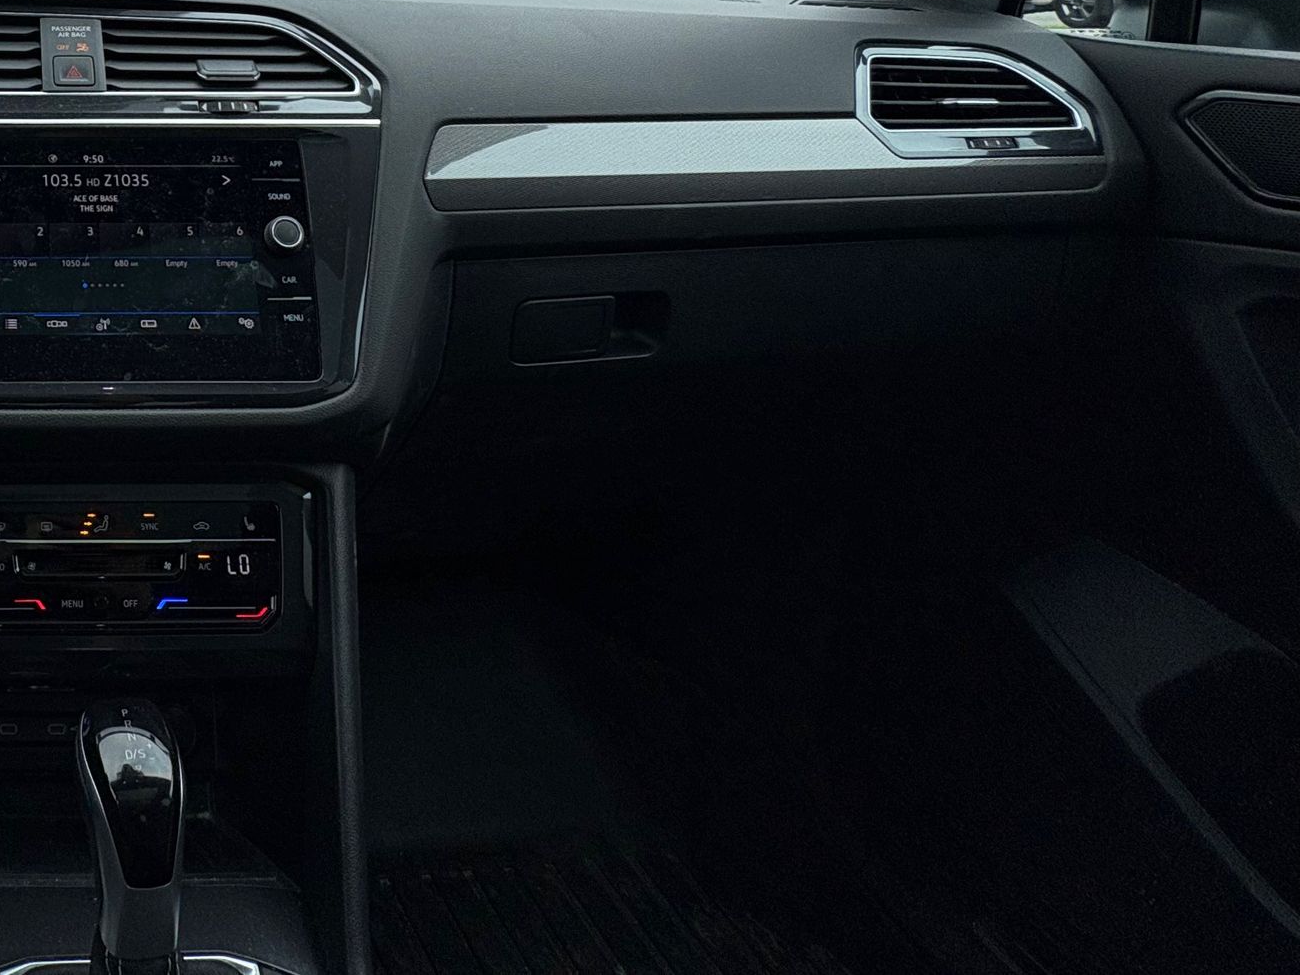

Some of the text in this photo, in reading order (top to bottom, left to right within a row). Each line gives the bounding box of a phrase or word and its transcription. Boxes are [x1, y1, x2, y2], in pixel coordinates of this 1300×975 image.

[83, 154, 104, 164] 9:50
[42, 173, 150, 187] 103.5 HD Z1035
[73, 194, 118, 202] ACE OF BASE
[267, 192, 291, 201] SOUND
[80, 204, 114, 212] THE SIGN
[36, 226, 44, 236] 2
[86, 226, 94, 236] 3
[135, 226, 144, 236] 4
[186, 226, 194, 236] 5
[236, 226, 244, 236] 6
[12, 259, 27, 267] 590
[61, 259, 80, 267] 1050
[165, 259, 188, 268] Empty
[216, 259, 238, 268] Empty
[281, 275, 298, 284] CAR
[283, 313, 304, 322] MENU
[140, 523, 159, 531] SYNC
[198, 562, 212, 571] A/C
[226, 553, 250, 575] LO
[61, 599, 84, 608] MENU
[123, 599, 139, 608] OFF
[121, 708, 129, 717] P
[124, 749, 146, 760] D/S
